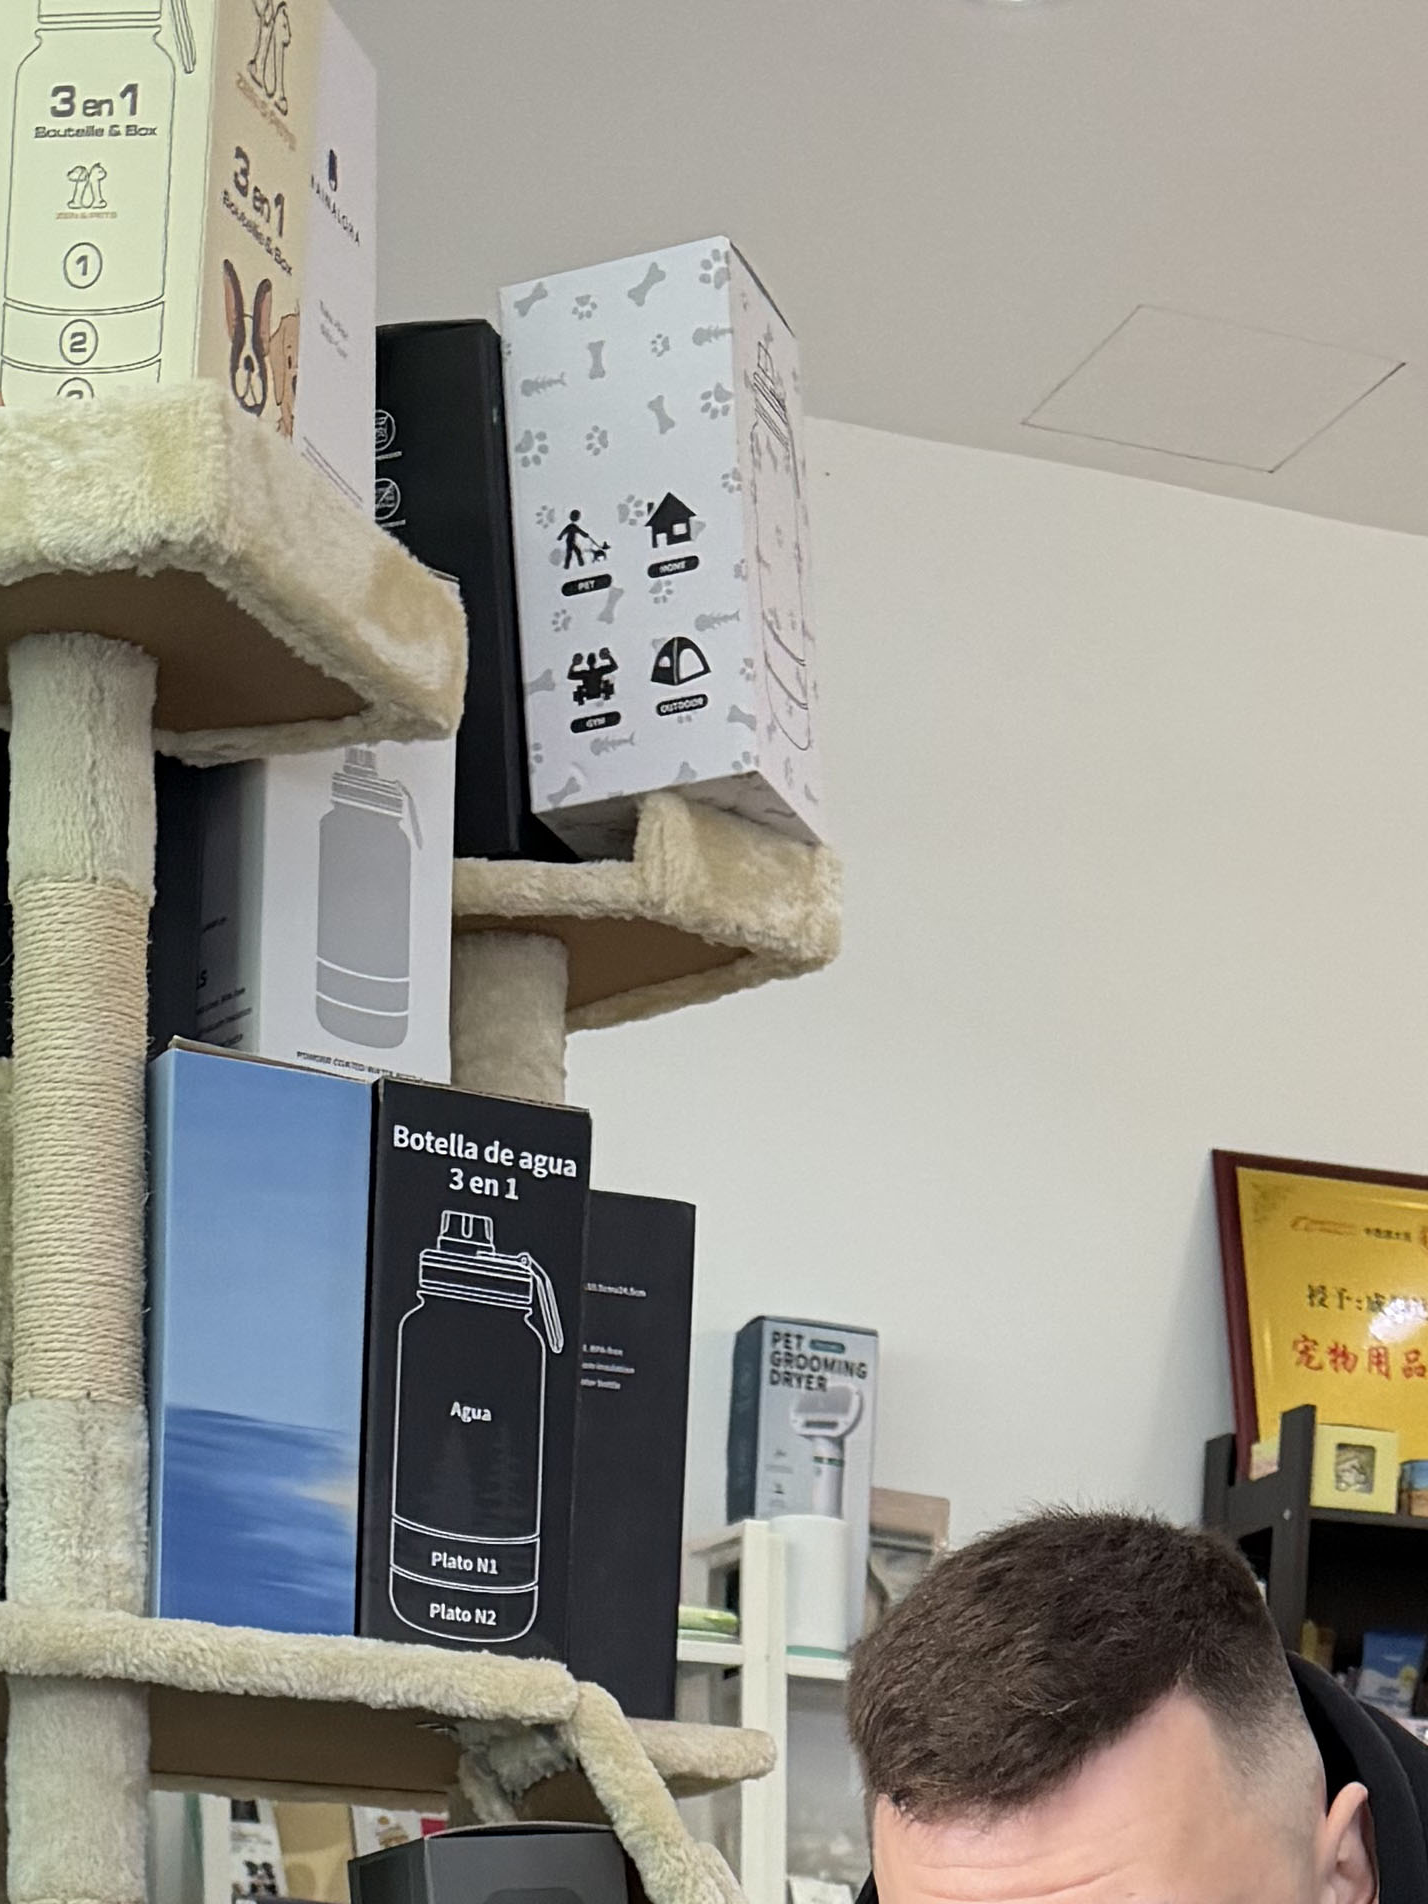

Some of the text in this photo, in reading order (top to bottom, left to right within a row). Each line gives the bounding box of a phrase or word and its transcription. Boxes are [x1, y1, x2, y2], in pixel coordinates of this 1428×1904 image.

[50, 83, 139, 118] 3 en 1
[125, 124, 158, 138] Box
[234, 146, 285, 238] 3 en 1
[76, 255, 88, 276] 1
[274, 247, 293, 277] Box
[69, 331, 87, 353] 2
[578, 580, 596, 591] PET
[586, 717, 606, 728] GYM
[393, 1124, 578, 1179] Botella de agua
[449, 1167, 519, 1200] 3 en 1
[771, 1331, 805, 1350] PET
[770, 1351, 868, 1380] GROOMING
[769, 1369, 828, 1392] DRYER
[450, 1401, 492, 1423] Agua
[431, 1551, 499, 1575] Plato N1
[429, 1602, 497, 1626] Plato N2
